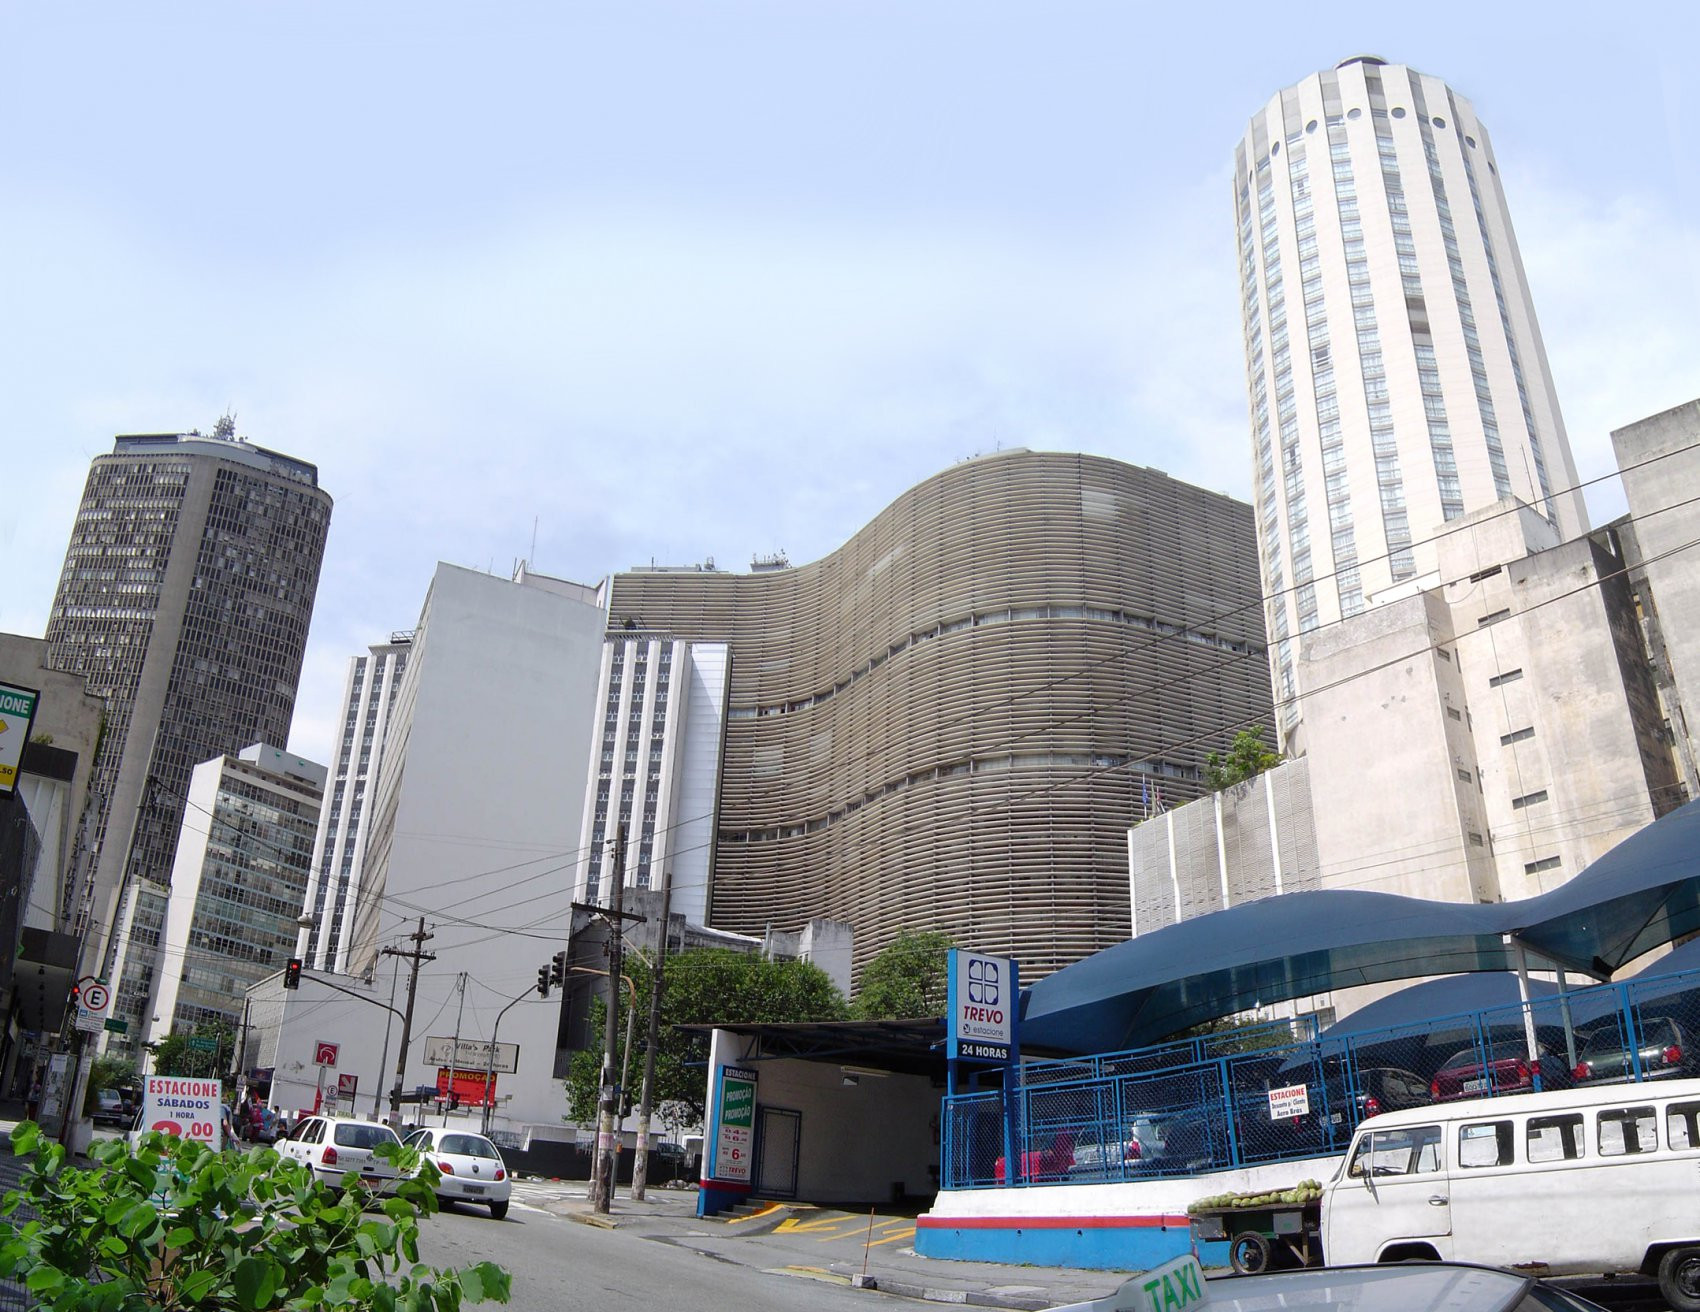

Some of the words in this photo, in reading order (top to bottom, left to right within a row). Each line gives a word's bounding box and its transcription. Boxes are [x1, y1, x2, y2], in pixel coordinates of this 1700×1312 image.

[91, 990, 102, 1005] E
[964, 1006, 1003, 1024] TREVO
[973, 1026, 1004, 1036] estacione
[962, 1044, 973, 1056] 24
[976, 1046, 1007, 1059] HORAS
[439, 1070, 496, 1082] PROMOÇÃO
[725, 1068, 757, 1081] ESTACIONE
[149, 1080, 217, 1097] ESTACIONE
[726, 1086, 752, 1102] PROMOÇÃO
[1270, 1088, 1304, 1100] ESTACIONE
[157, 1096, 210, 1109] SÁBADOS
[176, 1111, 195, 1119] HORA
[724, 1105, 751, 1121] PROMOÇÃO
[1143, 1262, 1202, 1312] TAXI
